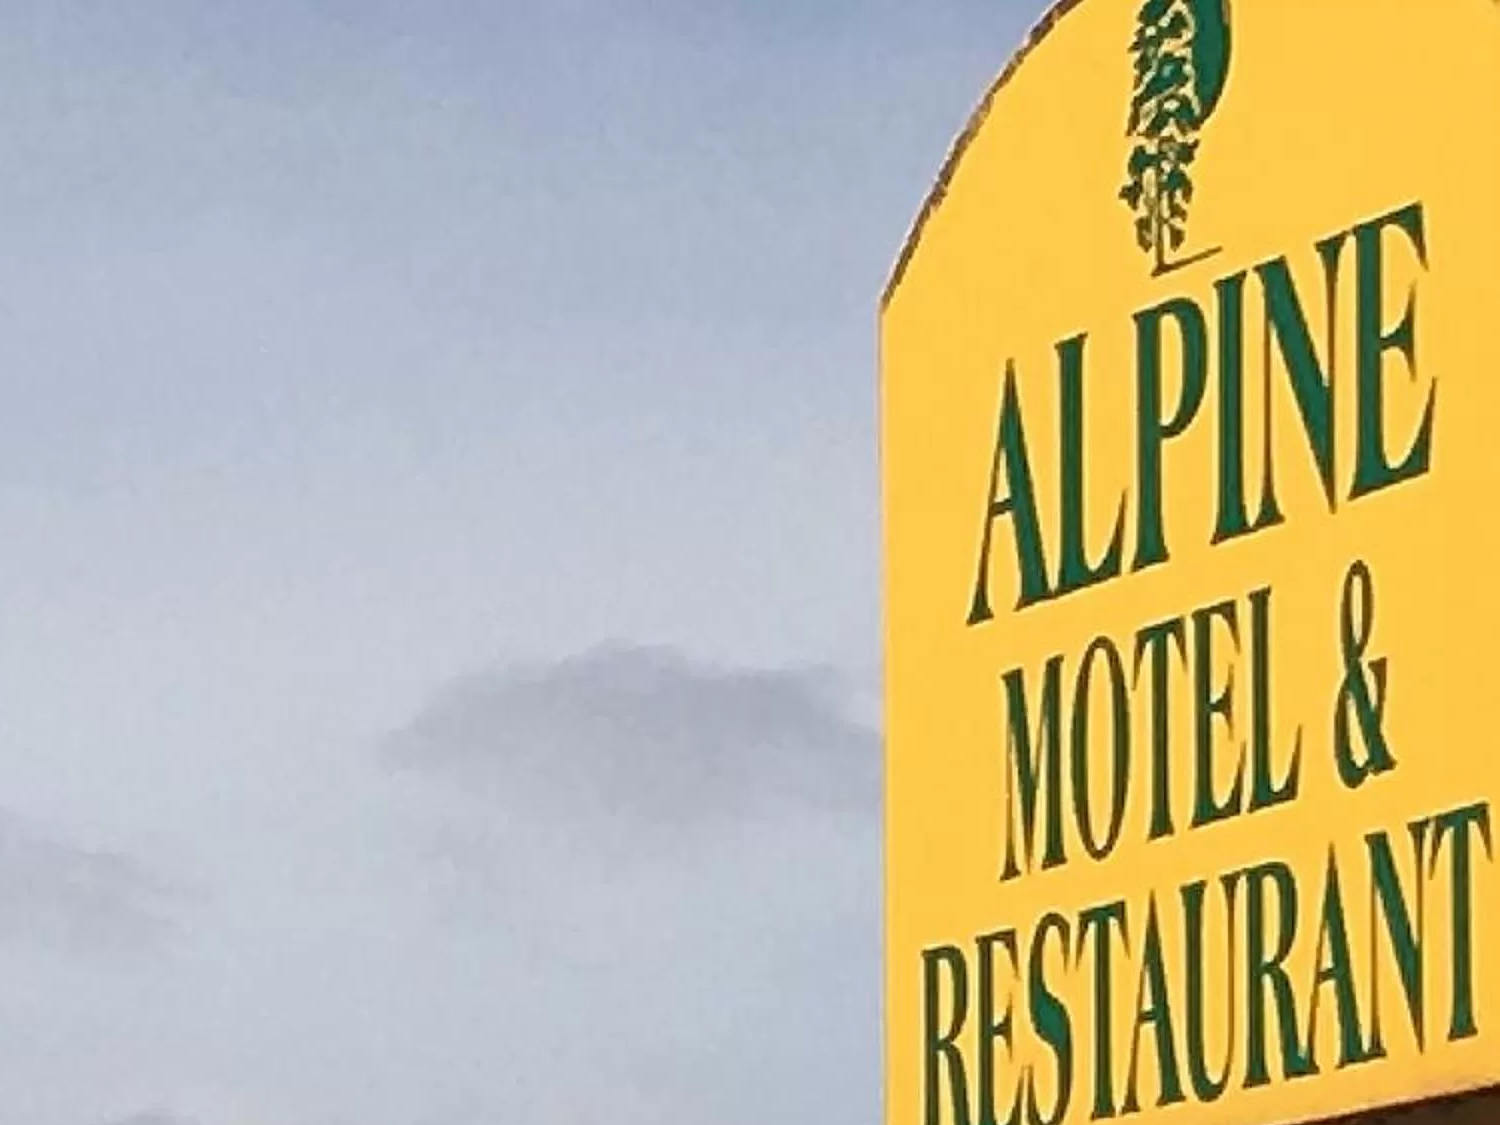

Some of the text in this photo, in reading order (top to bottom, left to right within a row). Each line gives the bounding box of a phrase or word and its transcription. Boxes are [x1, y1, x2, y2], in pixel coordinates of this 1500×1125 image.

[967, 201, 1438, 625] ALPINE
[999, 559, 1397, 883] MOTEL &
